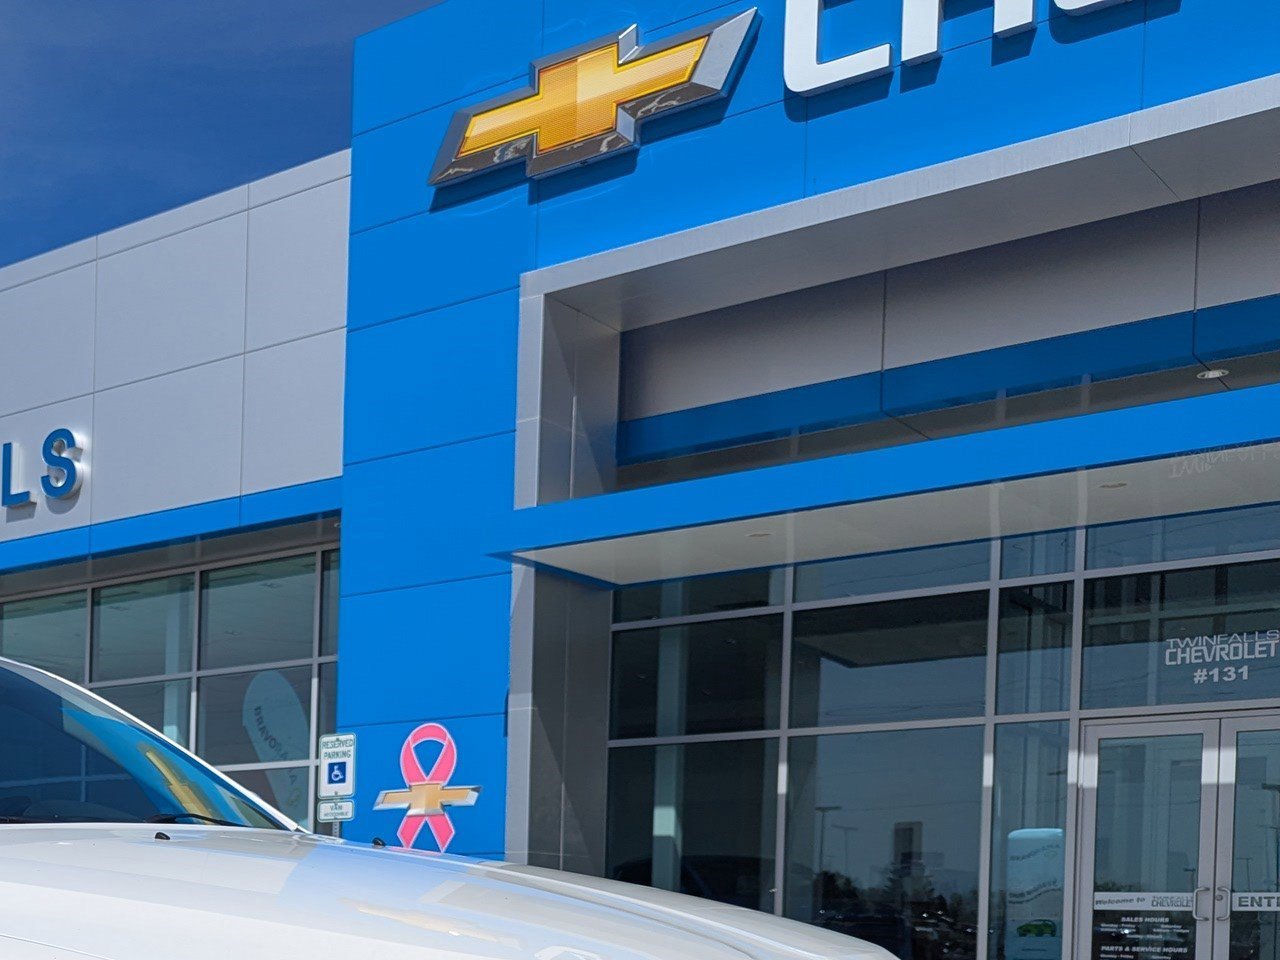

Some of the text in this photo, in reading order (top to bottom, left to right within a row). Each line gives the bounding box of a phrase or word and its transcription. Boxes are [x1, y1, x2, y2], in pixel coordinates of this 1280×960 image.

[1165, 640, 1279, 666] CHEVROLET
[1193, 665, 1249, 684] #131
[322, 739, 353, 749] RESERVED
[324, 750, 352, 760] PARKING
